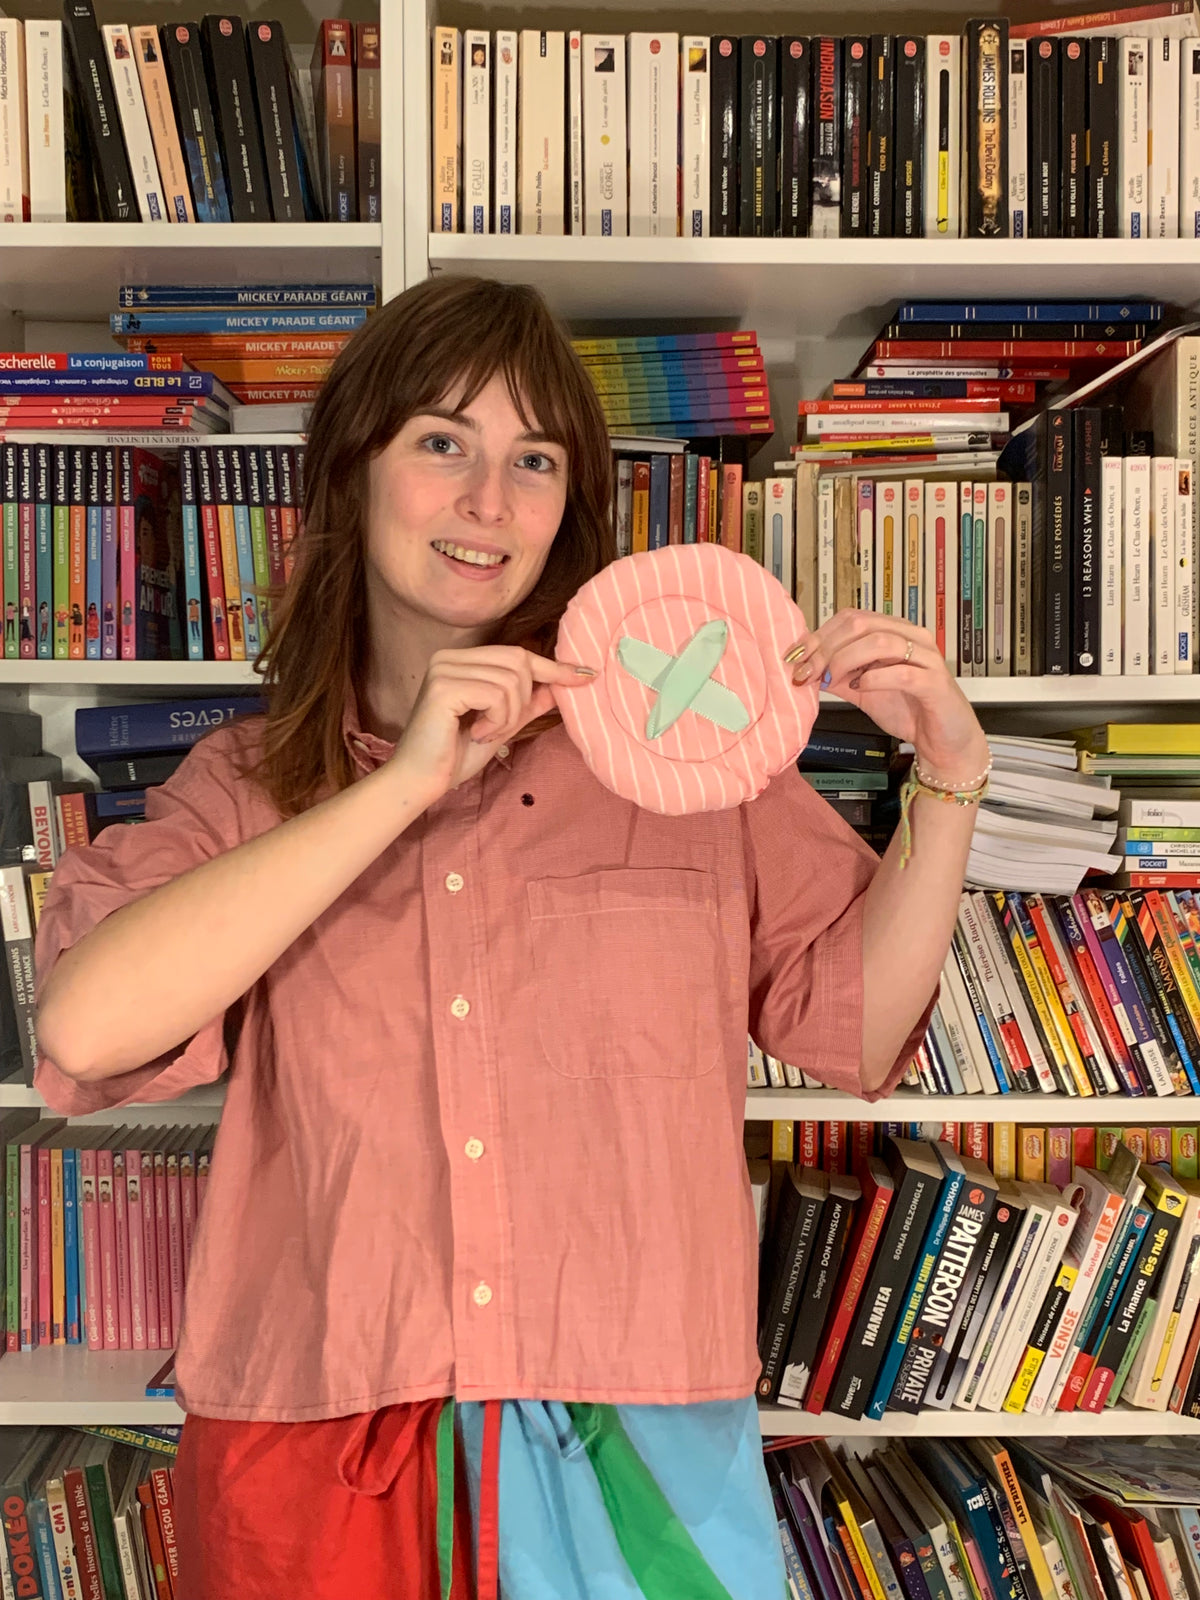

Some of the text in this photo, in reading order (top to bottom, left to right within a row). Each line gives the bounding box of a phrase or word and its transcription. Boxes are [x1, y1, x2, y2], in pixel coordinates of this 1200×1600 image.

[820, 42, 834, 118] INDRIDASON
[982, 52, 995, 189] JAMES ROLLINS The Devil Colony
[240, 144, 252, 192] Bernard Werber
[278, 149, 290, 197] Bernard Werber
[604, 162, 613, 200] GEORGE
[238, 289, 368, 302] MICKEY PARADE GÉANT
[227, 313, 355, 327] MICKEY PARADE GÉANT
[71, 357, 144, 370] La conjugaison
[246, 341, 334, 352] MICKEY PARADE
[134, 378, 181, 387] Le BLED
[248, 390, 289, 400] MICKEY
[1187, 354, 1198, 454] GRÈCE ANTIQUE
[6, 448, 14, 466] girls
[22, 449, 31, 467] girls
[38, 449, 47, 467] girls
[1052, 496, 1062, 559] LES POSSÉDÉS
[1083, 497, 1092, 524] WHY
[1083, 528, 1092, 581] REASONS
[1107, 516, 1115, 606] Lian Hearn Le Clan des
[1161, 550, 1168, 559] Le
[1083, 588, 1092, 597] 13
[1182, 585, 1190, 616] GRISHAM
[1179, 632, 1187, 660] POCKET
[964, 908, 993, 982] Thérèse Raquin
[11, 948, 26, 1005] LES SOUVERAINS
[23, 955, 33, 993] LA FRANCE
[1114, 961, 1127, 983] Fables
[1130, 1003, 1149, 1039] La Fontaine
[1146, 1047, 1166, 1086] LAROUSSE
[805, 1121, 813, 1158] GÉANT
[973, 1122, 982, 1158] GÉANT
[801, 1217, 813, 1236] KILL
[806, 1202, 816, 1216] TO
[892, 1181, 924, 1260] SONJA DELZONGLE
[932, 1180, 960, 1245] Dr Philippe BOXHO
[958, 1203, 986, 1223] JAMES
[812, 1203, 843, 1299] Savages DON WINSLOW
[1116, 1253, 1129, 1275] NICOLAS
[1140, 1226, 1169, 1276] les nuls
[780, 1248, 805, 1314] MOCKINGBIRD
[922, 1215, 983, 1327] PATTERSON
[1106, 1277, 1119, 1299] CAPTURE
[861, 1284, 892, 1348] THANATEA
[896, 1252, 935, 1344] ENTRETIEN AVEC UN CADAVRE
[1049, 1242, 1104, 1360] VENISE Routard
[1103, 1298, 1111, 1306] LA
[1116, 1277, 1148, 1333] La Finance
[1035, 1289, 1064, 1347] L'Histoire de France
[770, 1322, 786, 1356] HARPER
[764, 1356, 777, 1376] LEE
[900, 1346, 938, 1404] PRIVATE
[1019, 1356, 1039, 1392] LES NULS
[155, 1474, 170, 1505] GÉANT
[981, 1487, 994, 1510] TARDI
[1001, 1461, 1027, 1524] LABYRINTHES
[75, 1485, 100, 1600] belles histoires de la Bible
[161, 1509, 174, 1544] PICSOU
[3, 1496, 38, 1597] DOKÉO
[123, 1551, 132, 1575] Claude
